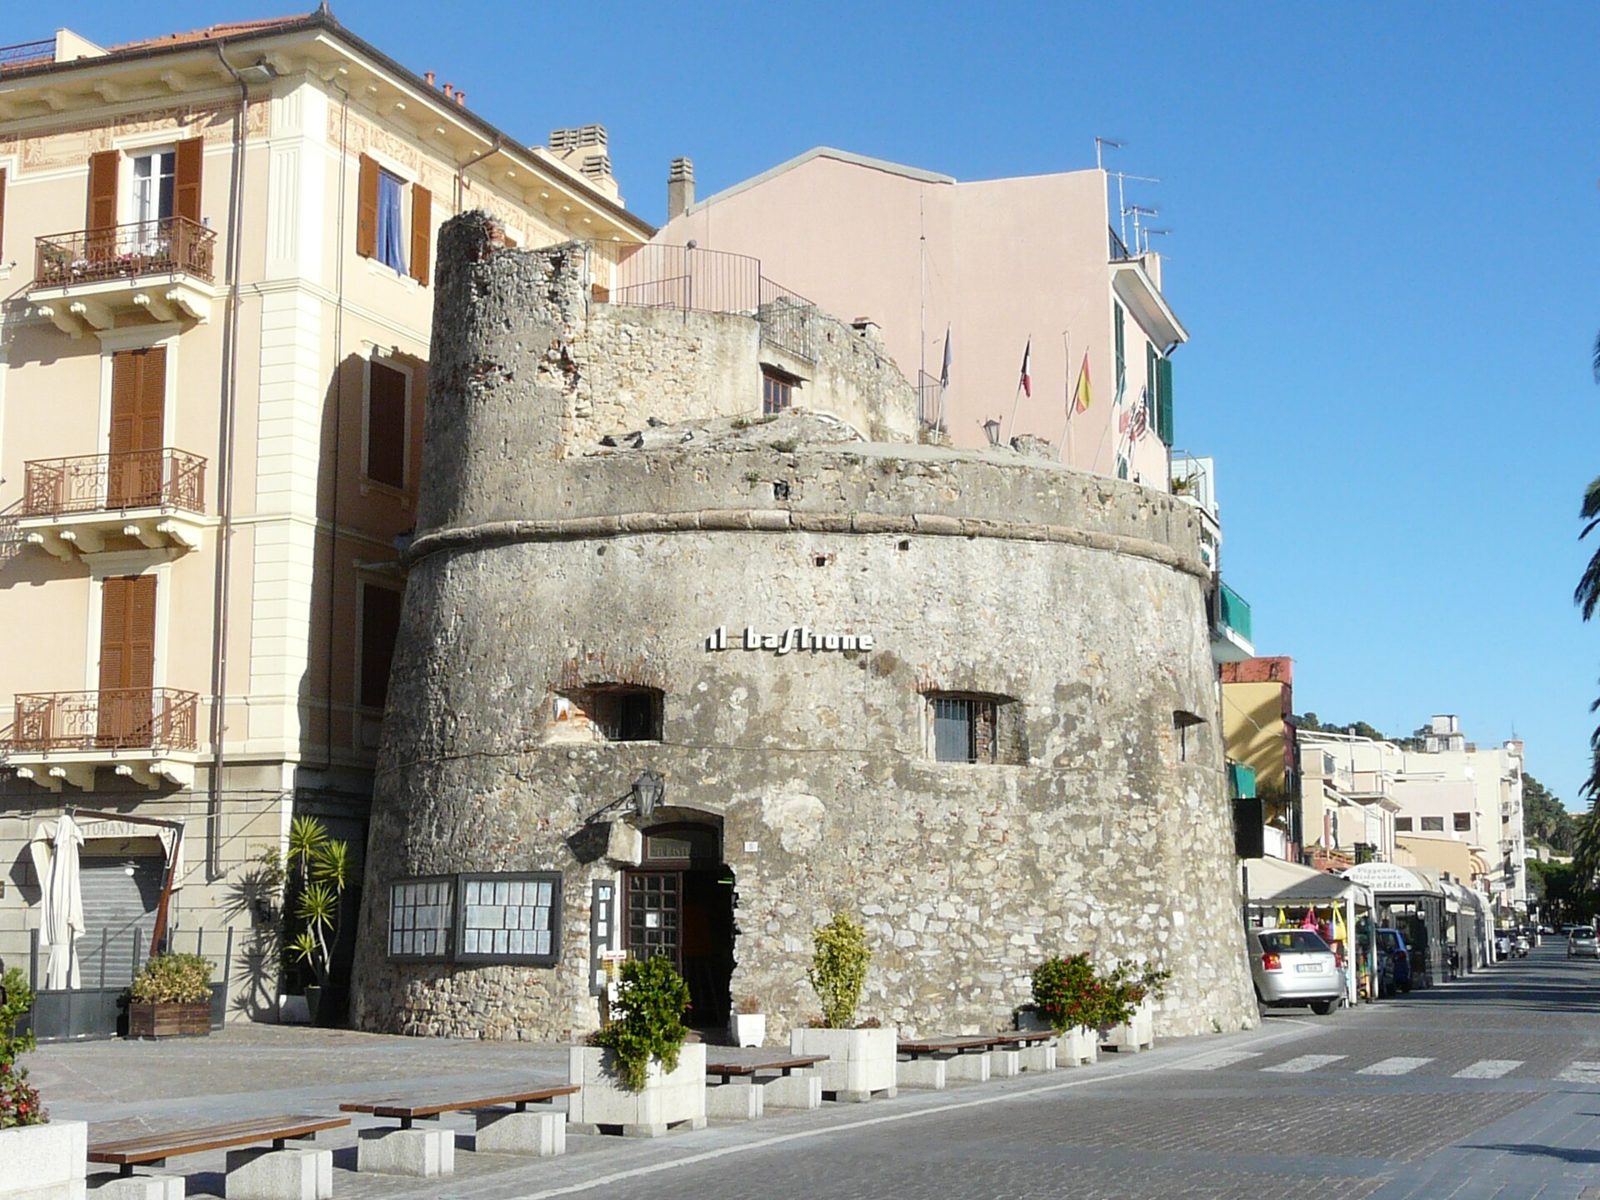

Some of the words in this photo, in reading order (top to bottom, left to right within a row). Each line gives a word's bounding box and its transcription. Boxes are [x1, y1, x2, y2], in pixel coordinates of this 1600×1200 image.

[708, 625, 727, 650] il
[745, 625, 873, 655] bastione
[80, 822, 137, 837] STORANTE
